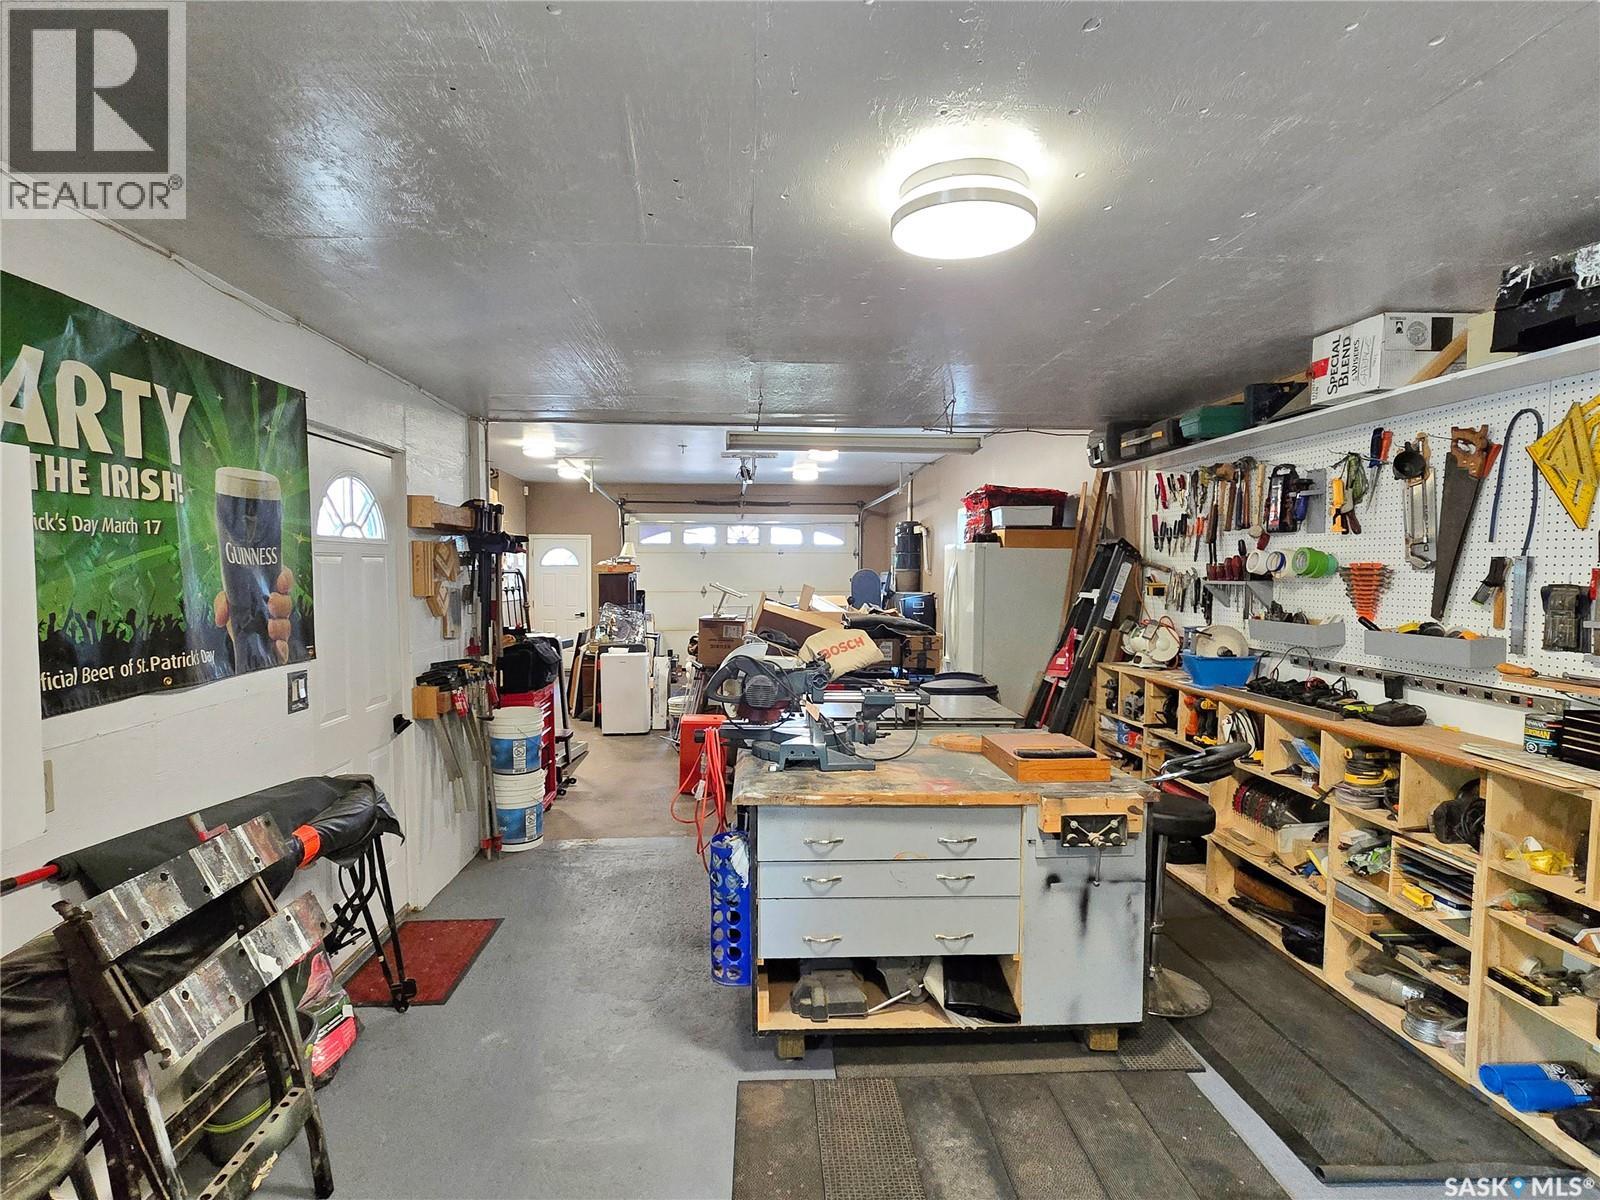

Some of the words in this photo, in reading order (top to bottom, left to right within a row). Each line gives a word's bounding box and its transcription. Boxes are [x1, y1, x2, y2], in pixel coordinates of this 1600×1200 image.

[1327, 334, 1342, 395] SPECIAL
[1338, 336, 1351, 388] BLEND
[0, 344, 193, 466] ARTY
[30, 452, 91, 495] THE
[100, 462, 184, 504] IRISH!
[71, 515, 99, 536] Day
[101, 517, 138, 534] March
[143, 519, 162, 535] 17
[225, 541, 278, 566] GUINNESS
[81, 666, 115, 684] Beer
[120, 658, 133, 677] of
[201, 649, 215, 665] Day
[820, 636, 866, 659] BOSCH
